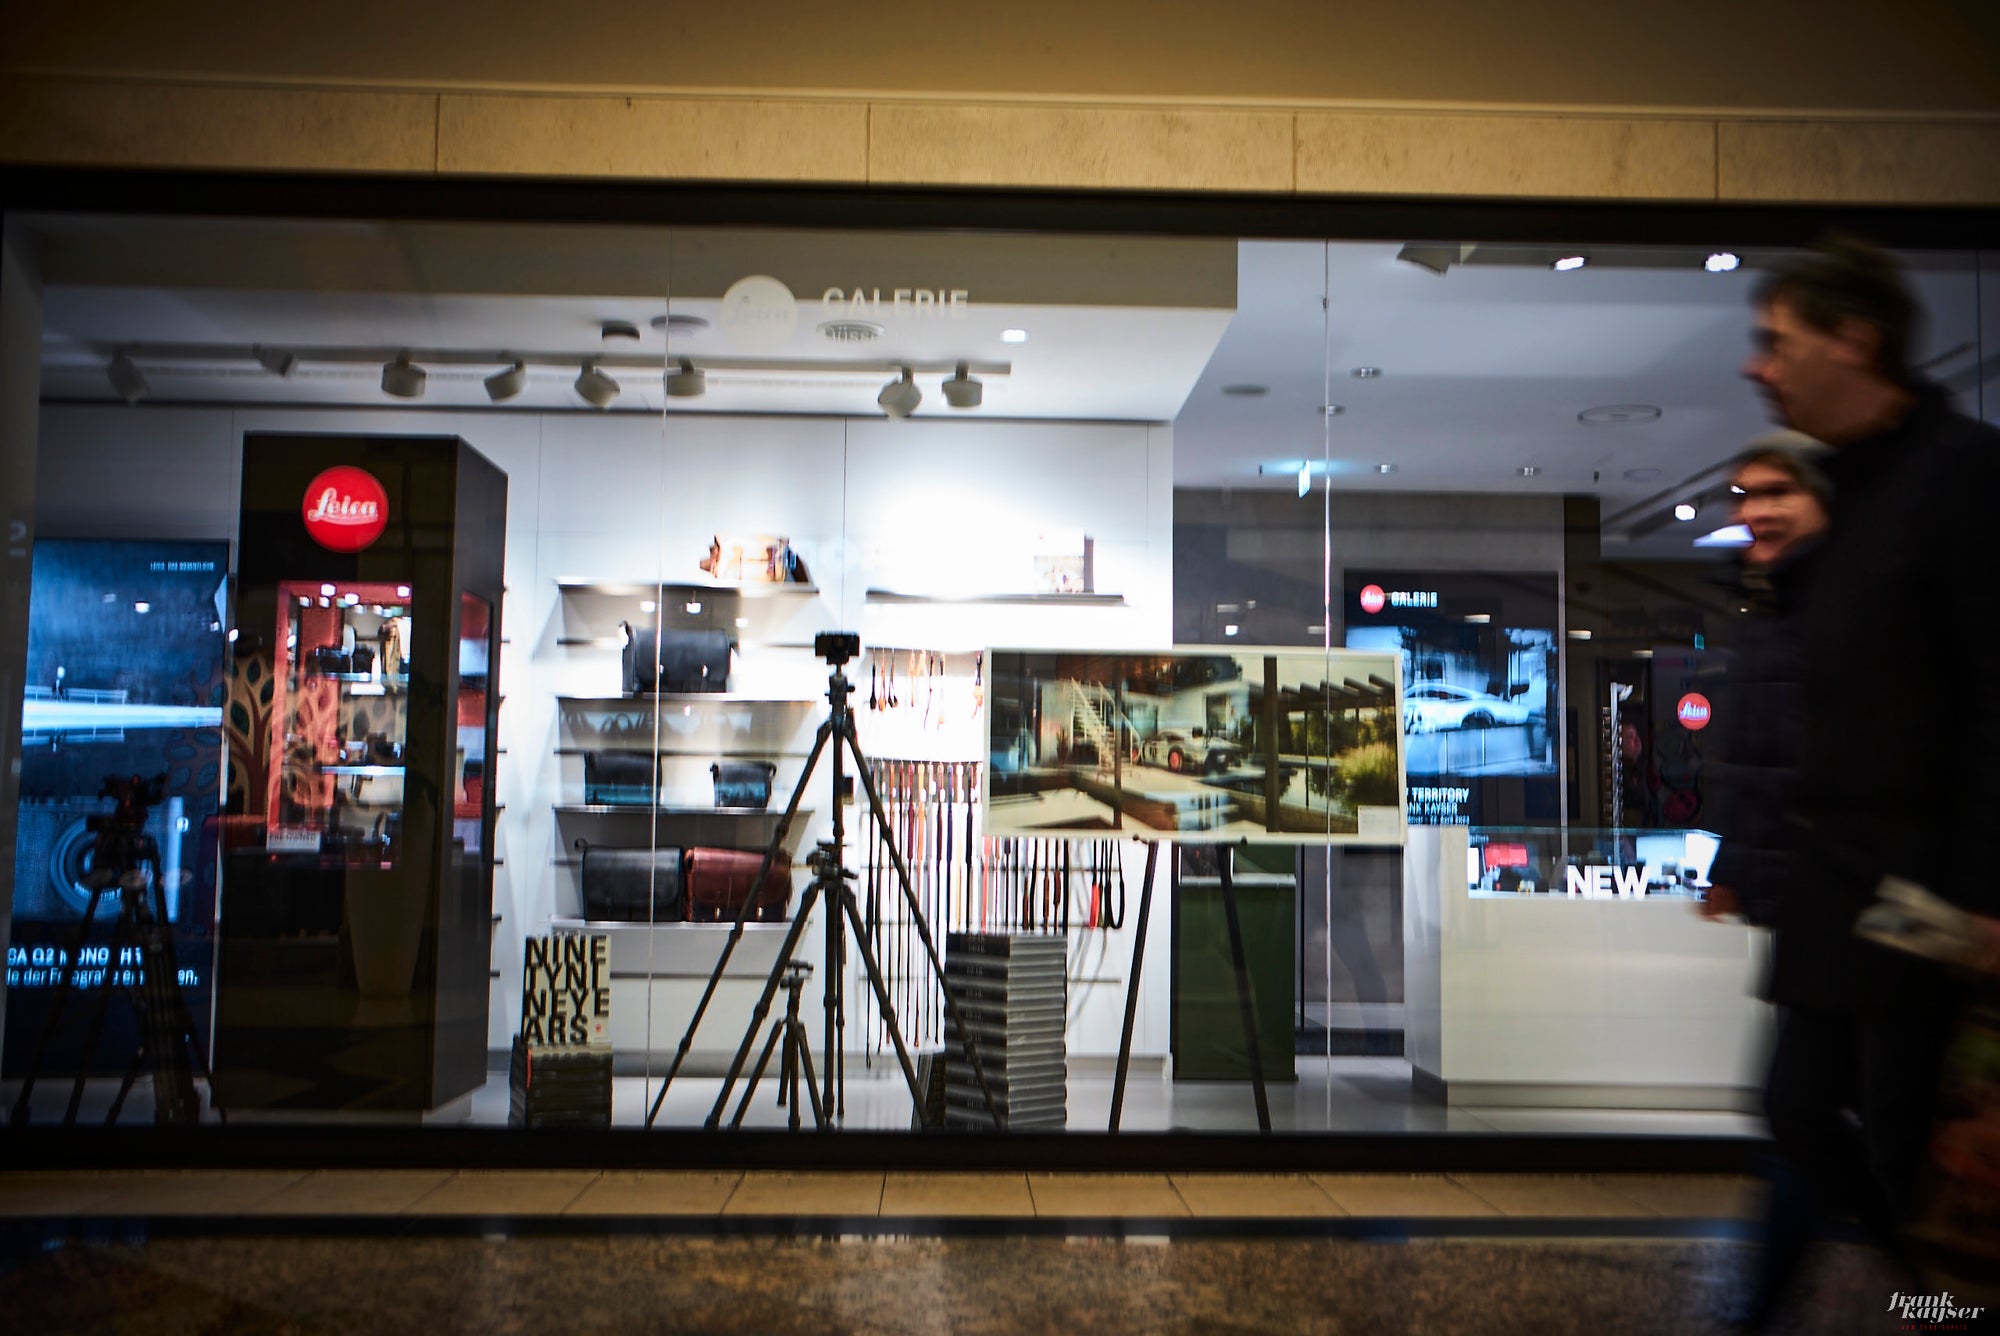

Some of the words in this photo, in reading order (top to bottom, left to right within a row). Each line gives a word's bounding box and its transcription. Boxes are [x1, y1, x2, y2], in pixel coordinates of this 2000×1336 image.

[822, 287, 968, 321] GALERIE
[307, 487, 379, 526] Leica
[1391, 591, 1438, 608] GALERIE
[1411, 787, 1470, 804] TERRITORY
[1424, 801, 1458, 816] KAYSER
[1567, 865, 1650, 900] NEW
[32, 947, 55, 966] Q2
[524, 935, 607, 966] NINE
[23, 968, 47, 986] der
[523, 989, 609, 1018] NEYE
[522, 1015, 588, 1044] ARS
